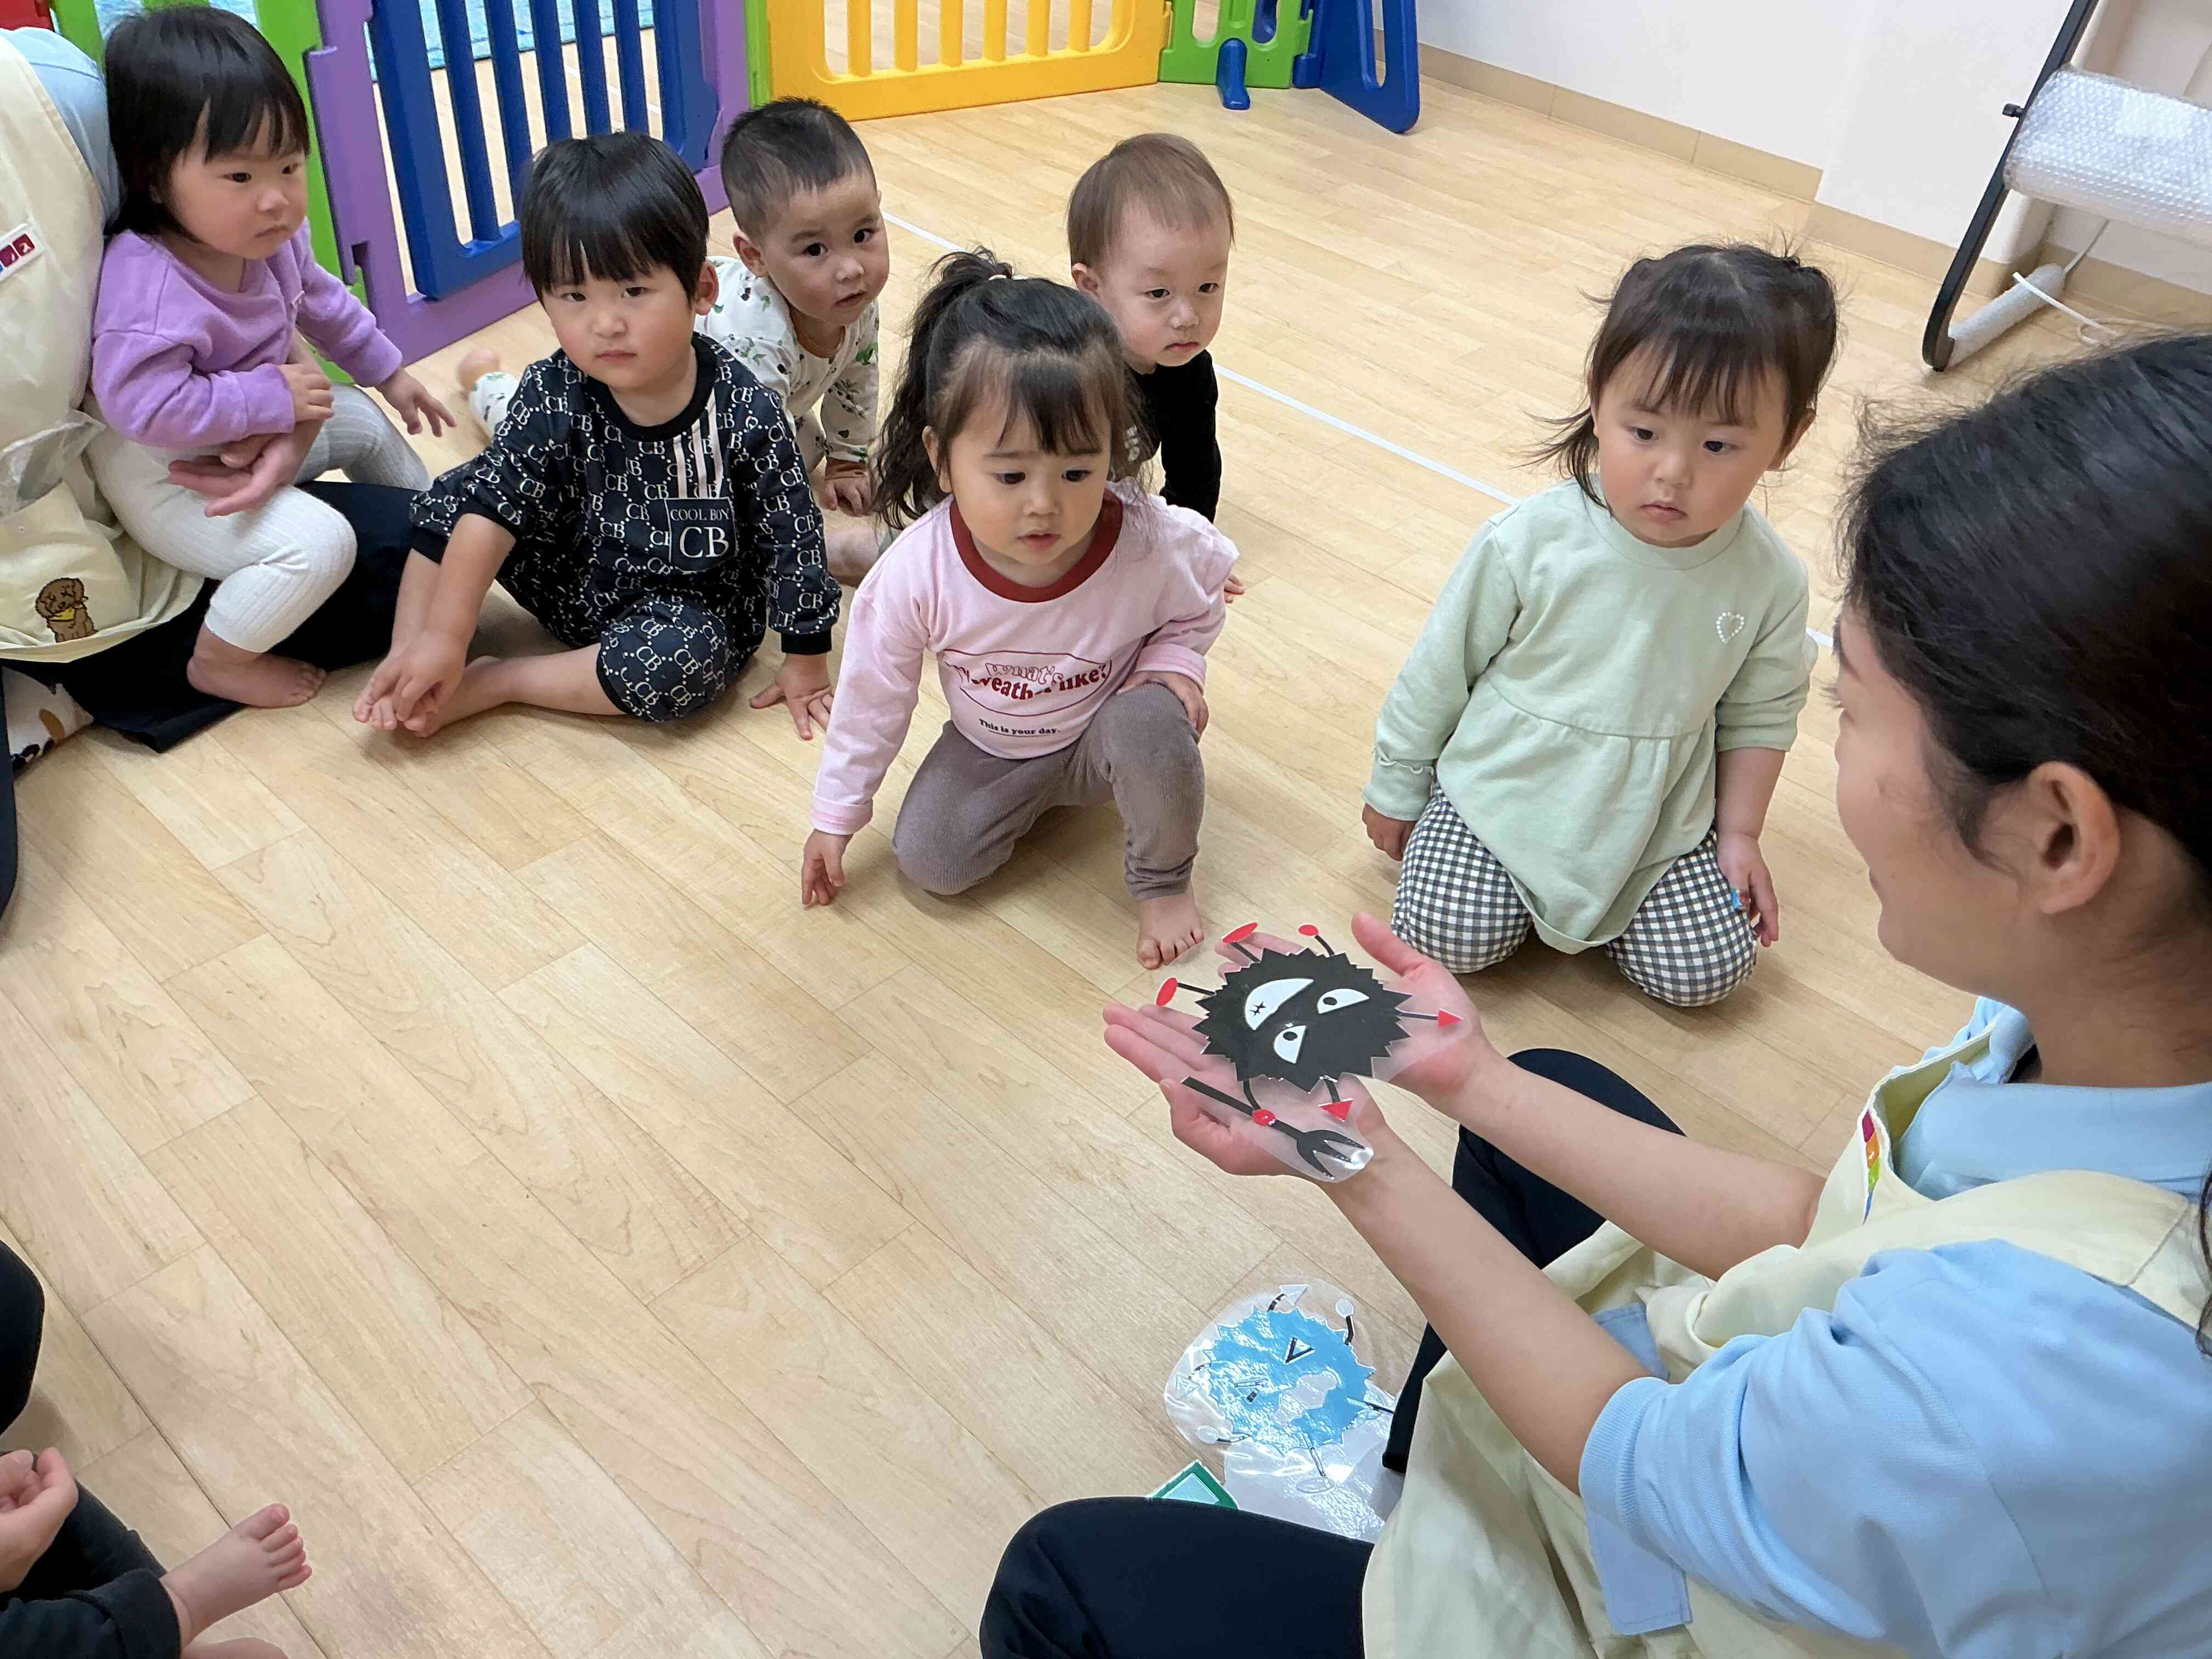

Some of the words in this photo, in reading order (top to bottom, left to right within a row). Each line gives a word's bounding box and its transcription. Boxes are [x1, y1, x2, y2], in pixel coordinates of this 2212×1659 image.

[719, 366, 732, 381] B
[545, 396, 567, 411] CB
[731, 387, 753, 403] CB
[511, 400, 530, 425] CB
[571, 414, 592, 431] CB
[638, 441, 665, 454] CB
[729, 433, 742, 449] B
[754, 453, 779, 474] CB
[475, 466, 500, 483] CB
[606, 474, 628, 492] CB
[780, 466, 803, 487] CB
[520, 478, 546, 498] CB
[644, 484, 669, 500] CB
[497, 501, 521, 525] CB
[627, 504, 650, 520] CB
[764, 495, 790, 513] CB
[670, 509, 707, 521] COOL
[710, 509, 729, 521] BOY
[794, 515, 815, 533] CB
[600, 522, 624, 539] CB
[680, 527, 729, 558] CB
[797, 549, 821, 567] CB
[799, 592, 823, 609] CB
[641, 619, 663, 636] CB
[777, 610, 795, 627] CB
[672, 617, 696, 639] CB
[702, 624, 719, 651] CB
[636, 646, 662, 671] CB
[674, 648, 699, 675] CB
[635, 681, 659, 706] CB
[670, 685, 692, 706] CB
[971, 678, 1051, 699] weath
[979, 719, 998, 731] This
